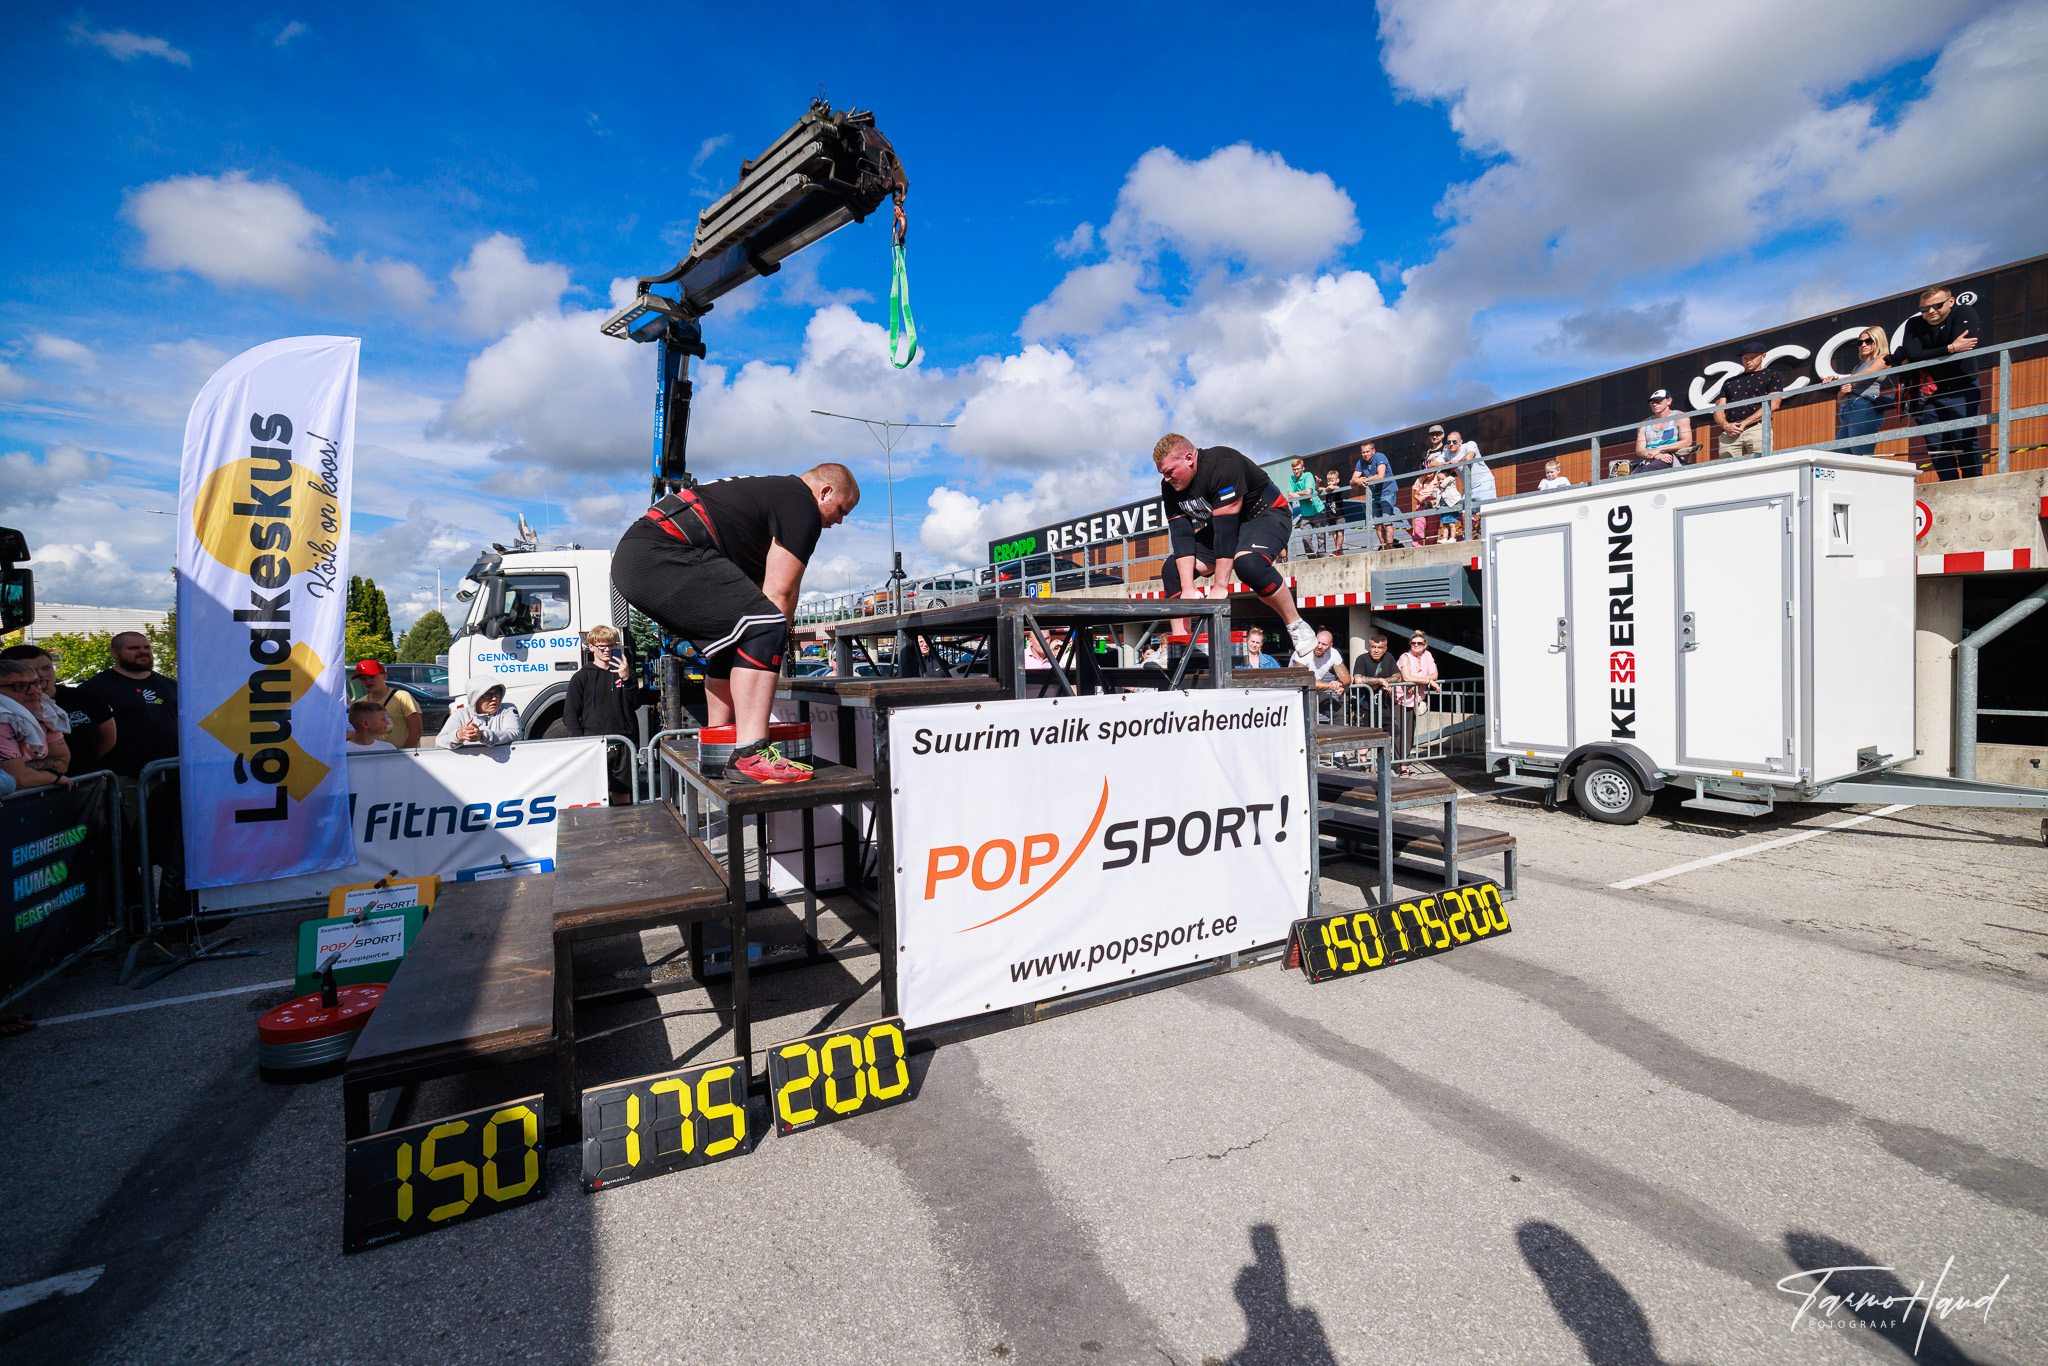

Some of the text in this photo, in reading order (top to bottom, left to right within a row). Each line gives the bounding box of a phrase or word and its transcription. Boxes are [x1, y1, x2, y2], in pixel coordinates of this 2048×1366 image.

[306, 431, 339, 599] Kõik on koos!
[993, 536, 1037, 563] CROPP
[233, 412, 293, 823] Lõunakeskus
[515, 637, 579, 649] 5560 9057
[477, 652, 518, 662] GENNO
[493, 662, 549, 673] TÕSTEABI
[912, 705, 1289, 756] Suurim valik spordivahendeid!
[12, 824, 87, 868] ENGINEERING
[924, 794, 1290, 900] POP SPORT!
[13, 860, 69, 902] HUMAN
[376, 899, 416, 911] SPORT!
[320, 932, 402, 954] POP SPORT!
[1010, 914, 1239, 983] www.popsport.ee
[1321, 913, 1385, 972] 150
[1391, 898, 1451, 952] 175
[1443, 884, 1509, 941] 200
[777, 1024, 910, 1126] 200
[626, 1066, 746, 1168] 175
[397, 1105, 538, 1222] 150
